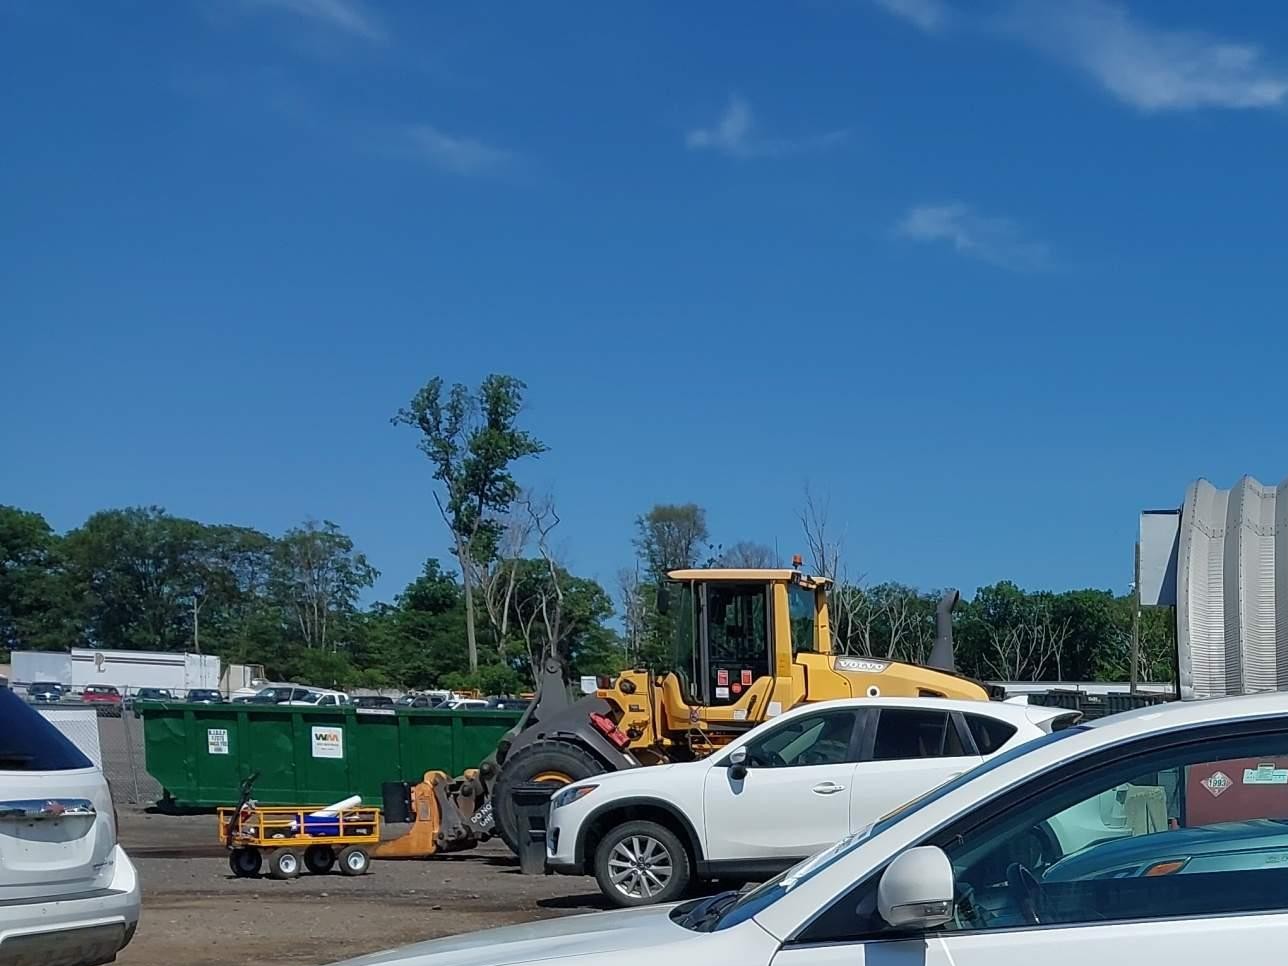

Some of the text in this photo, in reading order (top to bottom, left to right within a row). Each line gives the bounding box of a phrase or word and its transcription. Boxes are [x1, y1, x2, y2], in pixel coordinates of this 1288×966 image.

[839, 660, 884, 669] VOLVO
[314, 733, 340, 742] WM
[470, 802, 492, 824] DO NO
